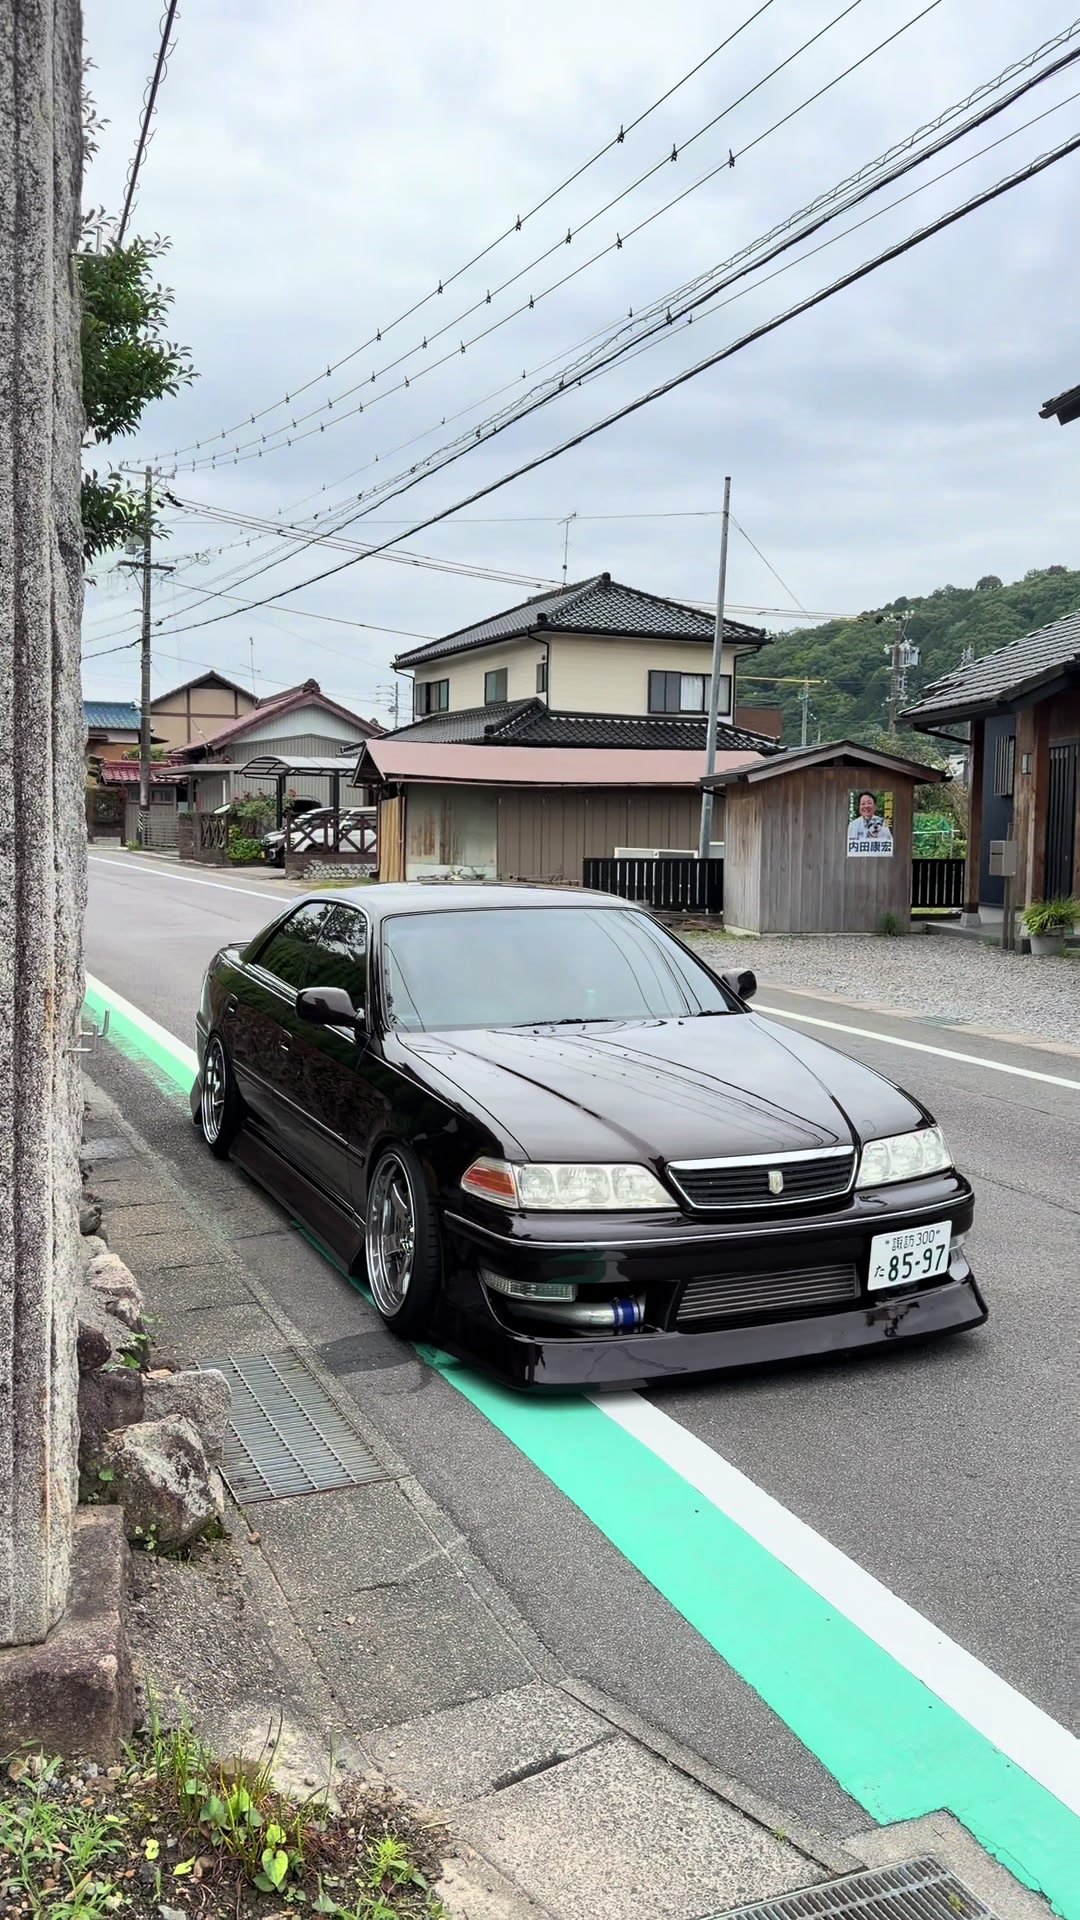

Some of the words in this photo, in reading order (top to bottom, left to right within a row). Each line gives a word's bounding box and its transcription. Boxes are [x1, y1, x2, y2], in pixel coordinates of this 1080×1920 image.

[848, 841, 892, 852] 内田康宏
[915, 1229, 935, 1246] 300
[874, 1265, 885, 1278] た
[887, 1244, 946, 1282] 85-97
